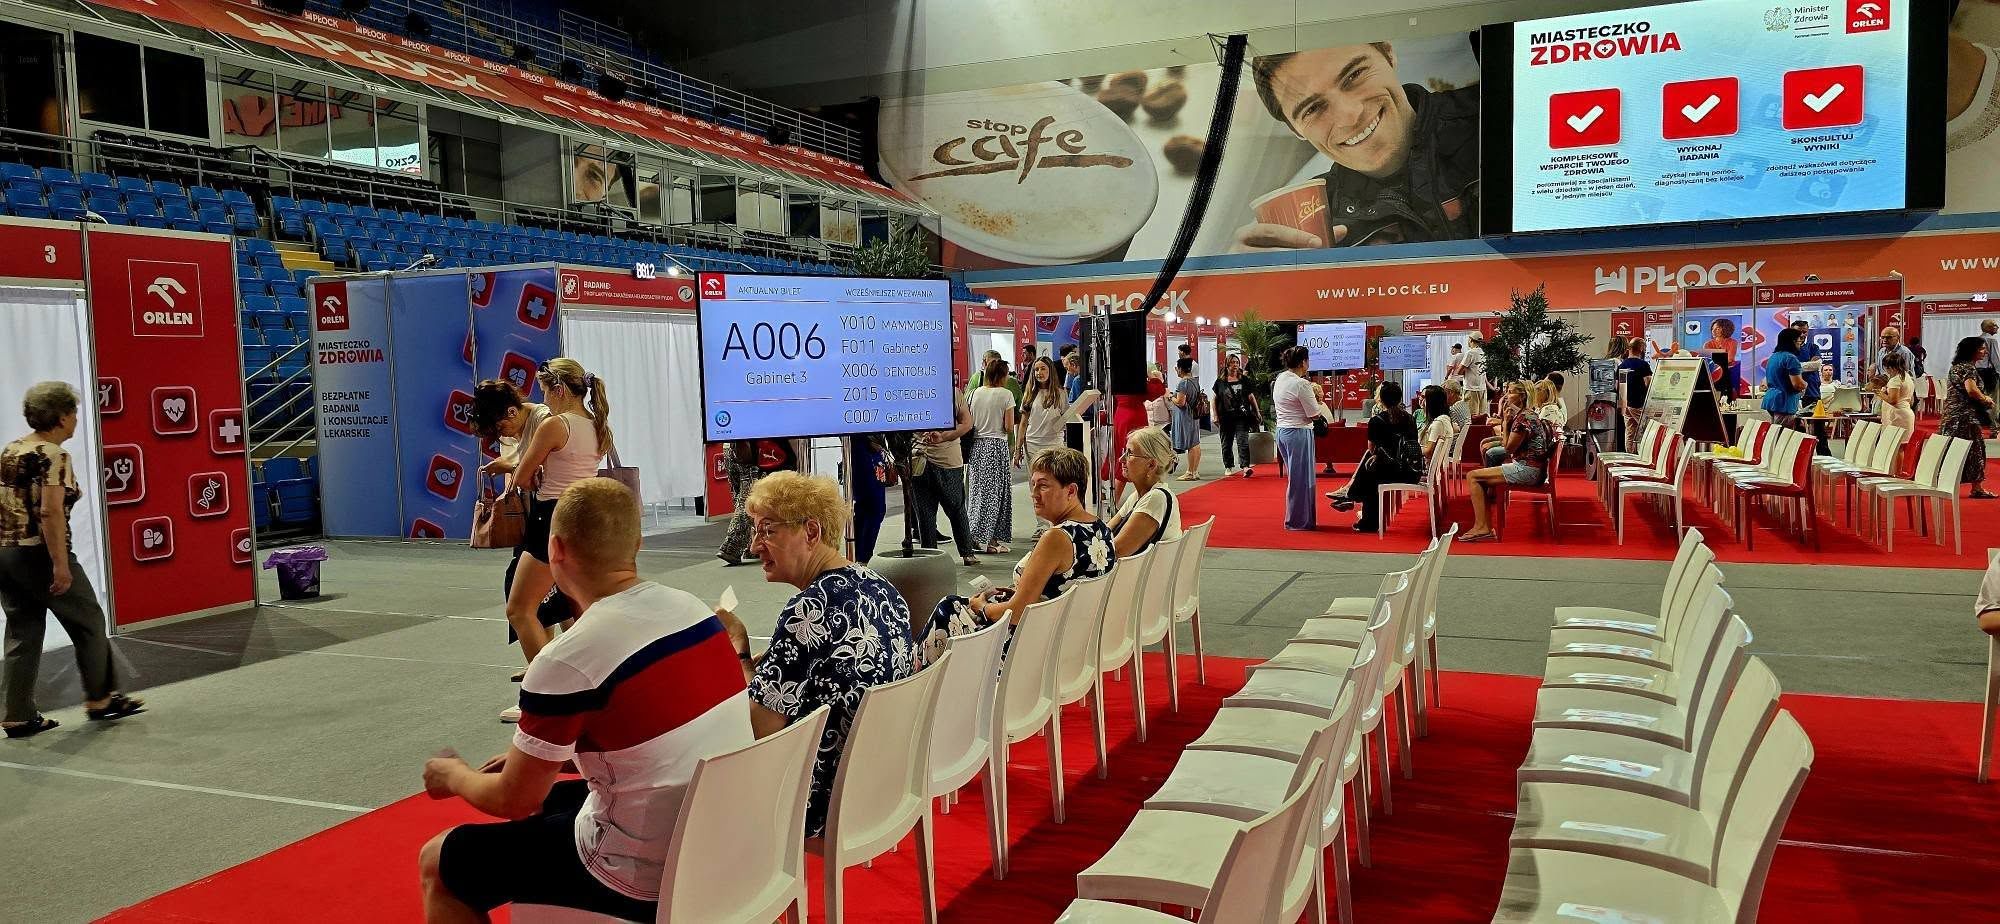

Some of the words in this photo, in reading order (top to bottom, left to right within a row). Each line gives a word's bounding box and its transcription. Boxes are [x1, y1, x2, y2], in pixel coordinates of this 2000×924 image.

[1794, 5, 1829, 14] Minister
[312, 14, 339, 29] PŁOCK
[1793, 13, 1829, 23] Zdrowia
[1852, 18, 1884, 28] ORLEN
[361, 25, 387, 41] PŁOCK
[1530, 21, 1650, 45] MIASTECZKO
[407, 40, 431, 54] PŁOCK
[1530, 32, 1682, 66] ZDROWIA
[449, 51, 471, 64] PŁOCK
[490, 63, 509, 74] PŁOCK
[525, 72, 544, 84] PŁOCK
[966, 118, 1028, 136] stop
[1790, 133, 1854, 145] SKONSULTUJ
[932, 115, 1087, 185] cafe
[1677, 144, 1722, 153] WYKONAJ
[1803, 143, 1840, 152] WYNIKI
[1550, 152, 1619, 163] KOMPLEKSOWE
[1679, 152, 1720, 162] BADANIA
[1540, 160, 1584, 171] WSPARCIE
[1586, 158, 1630, 168] TWOJEGO
[1765, 163, 1796, 173] zdobądź
[1798, 161, 1838, 169] wskazówki
[1838, 159, 1877, 168] dotyczące
[1563, 168, 1605, 176] ZDROWIA
[1779, 170, 1812, 179] dalszego
[1705, 176, 1718, 184] bez
[1719, 174, 1745, 184] kolejek
[44, 244, 57, 264] 3
[1940, 256, 1999, 271] WWW
[1633, 260, 1766, 294] PŁOCK
[738, 286, 779, 295] AKTUALNY
[780, 287, 801, 295] BILET
[845, 287, 895, 297] WCZEŚNIEJSZE
[896, 289, 934, 298] WEZWANIA
[1316, 283, 1449, 299] WWW.PLOCK.EU
[143, 311, 193, 325] ORLEN
[321, 315, 345, 324] ORLEN
[839, 315, 876, 330] Y010
[881, 320, 944, 331] MAMMOBUS
[318, 340, 370, 351] MIASTECZKO
[722, 322, 826, 360] A006
[842, 339, 875, 354] F011
[882, 342, 920, 354] Gabinet
[922, 343, 929, 353] 9
[1302, 336, 1330, 349] A006
[318, 349, 384, 364] ZDROWIA
[841, 363, 878, 378] X006
[883, 366, 937, 377] DENTOBUS
[746, 371, 797, 385] Gabinet
[800, 370, 808, 383] 3
[321, 391, 370, 401] BEZPŁATNE
[843, 386, 878, 401] Z015
[884, 388, 937, 400] OSTEOBUS
[322, 404, 360, 413] BADANIA
[328, 416, 389, 426] KONSULTACJE
[844, 409, 879, 424] C007
[885, 411, 923, 423] Gabinet
[925, 410, 931, 421] 5
[324, 429, 371, 438] LEKARSKIE
